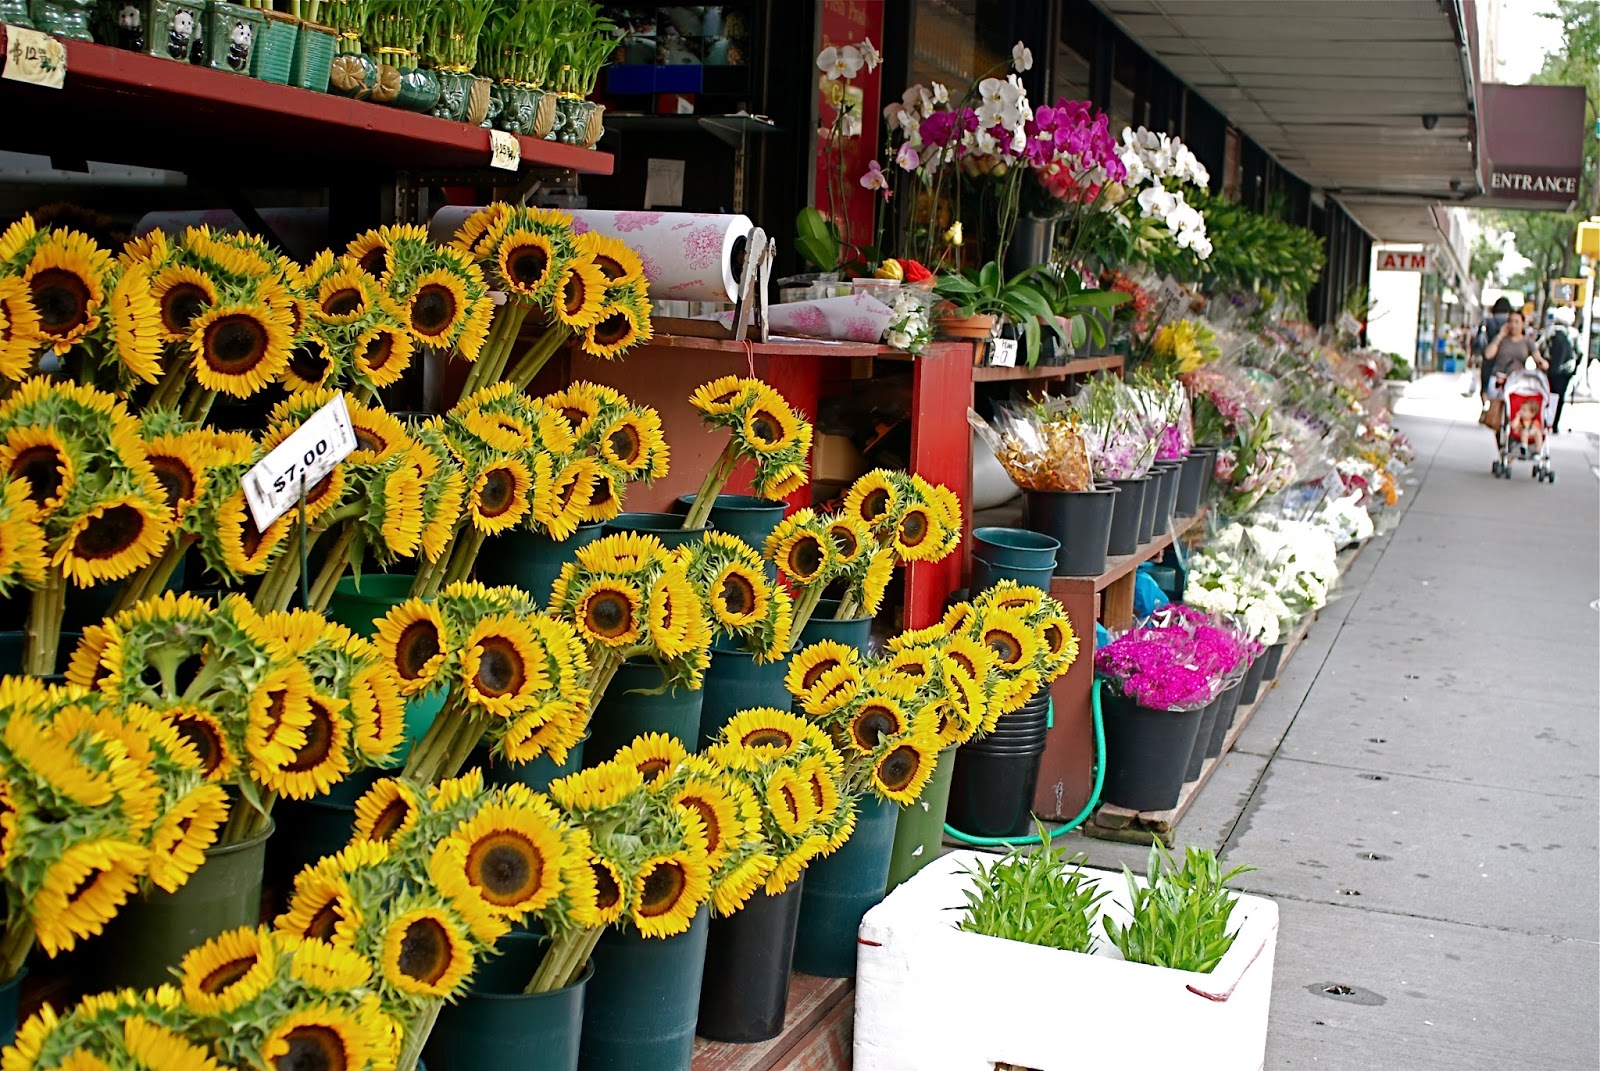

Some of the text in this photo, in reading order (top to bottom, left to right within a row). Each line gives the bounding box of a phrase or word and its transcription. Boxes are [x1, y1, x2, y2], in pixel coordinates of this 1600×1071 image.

[1491, 173, 1577, 194] ENTRANCE
[1383, 253, 1426, 269] ATM
[273, 439, 328, 493] $7.00
